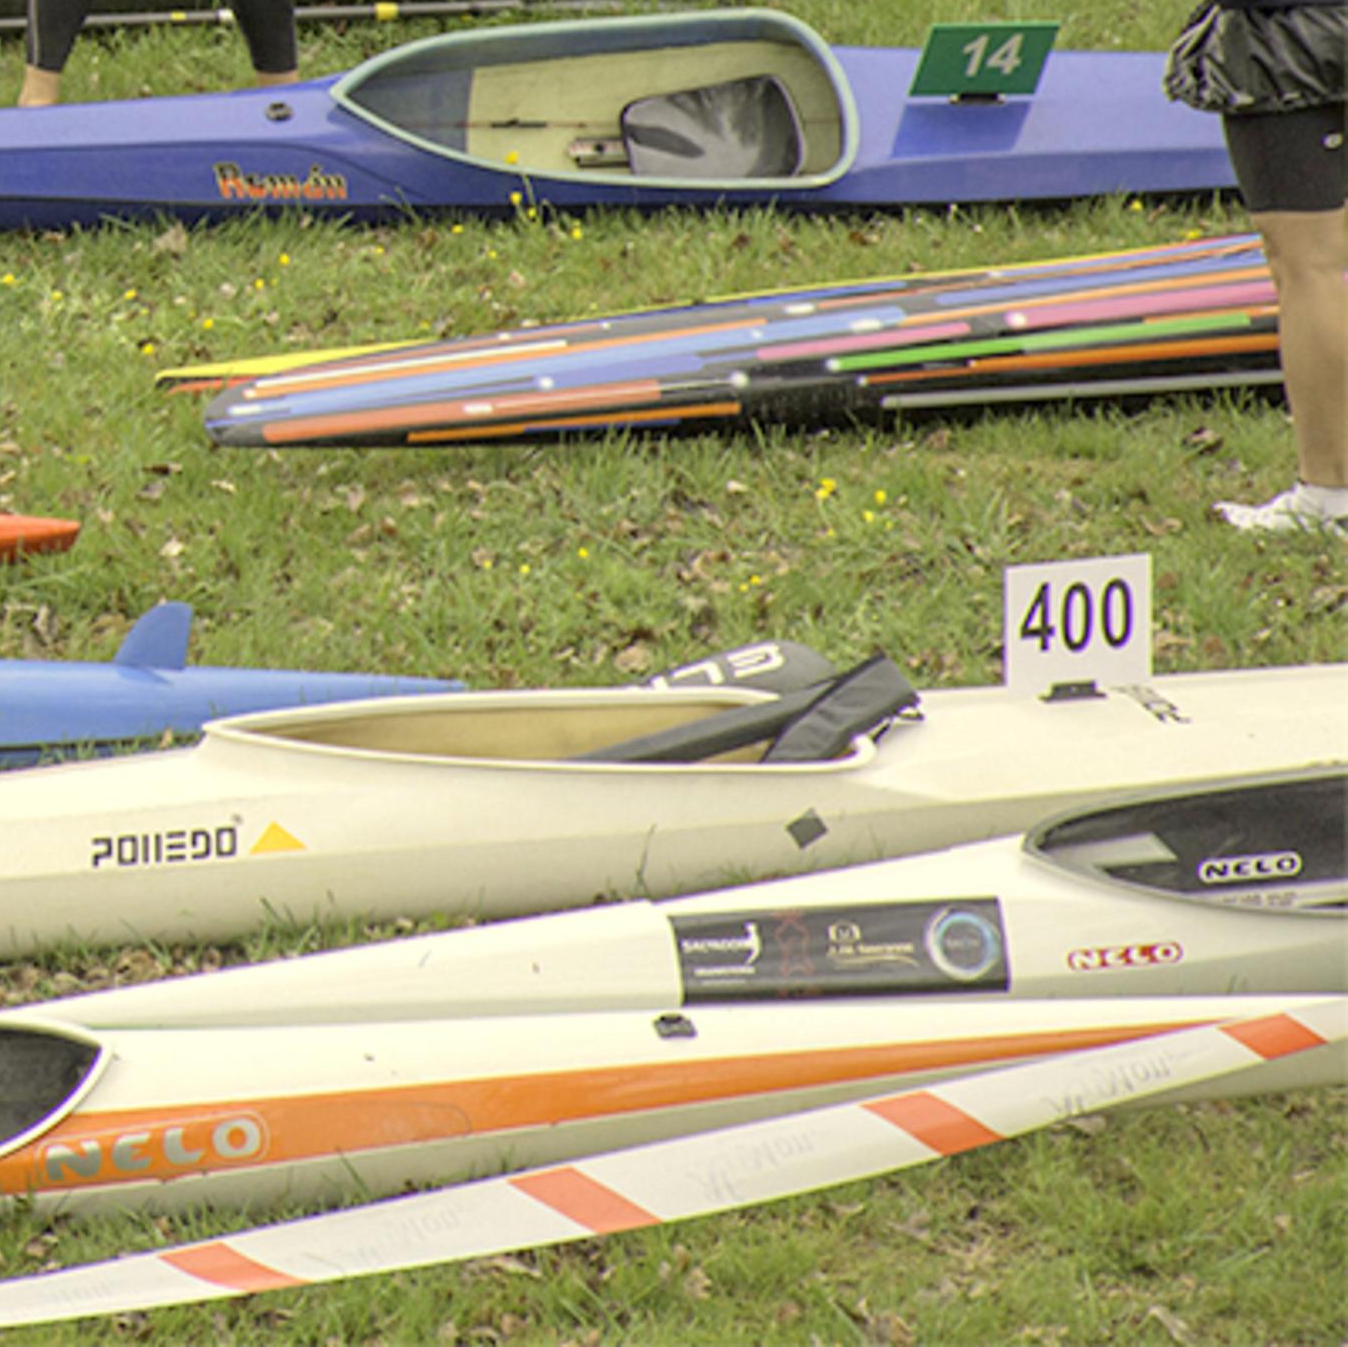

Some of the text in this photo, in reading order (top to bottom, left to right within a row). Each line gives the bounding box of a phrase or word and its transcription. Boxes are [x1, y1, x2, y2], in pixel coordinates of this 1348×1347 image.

[962, 32, 1024, 77] 14
[1019, 576, 1134, 653] 400
[1203, 855, 1299, 881] NELO
[1069, 942, 1181, 971] NELO
[45, 1118, 261, 1182] NELO
